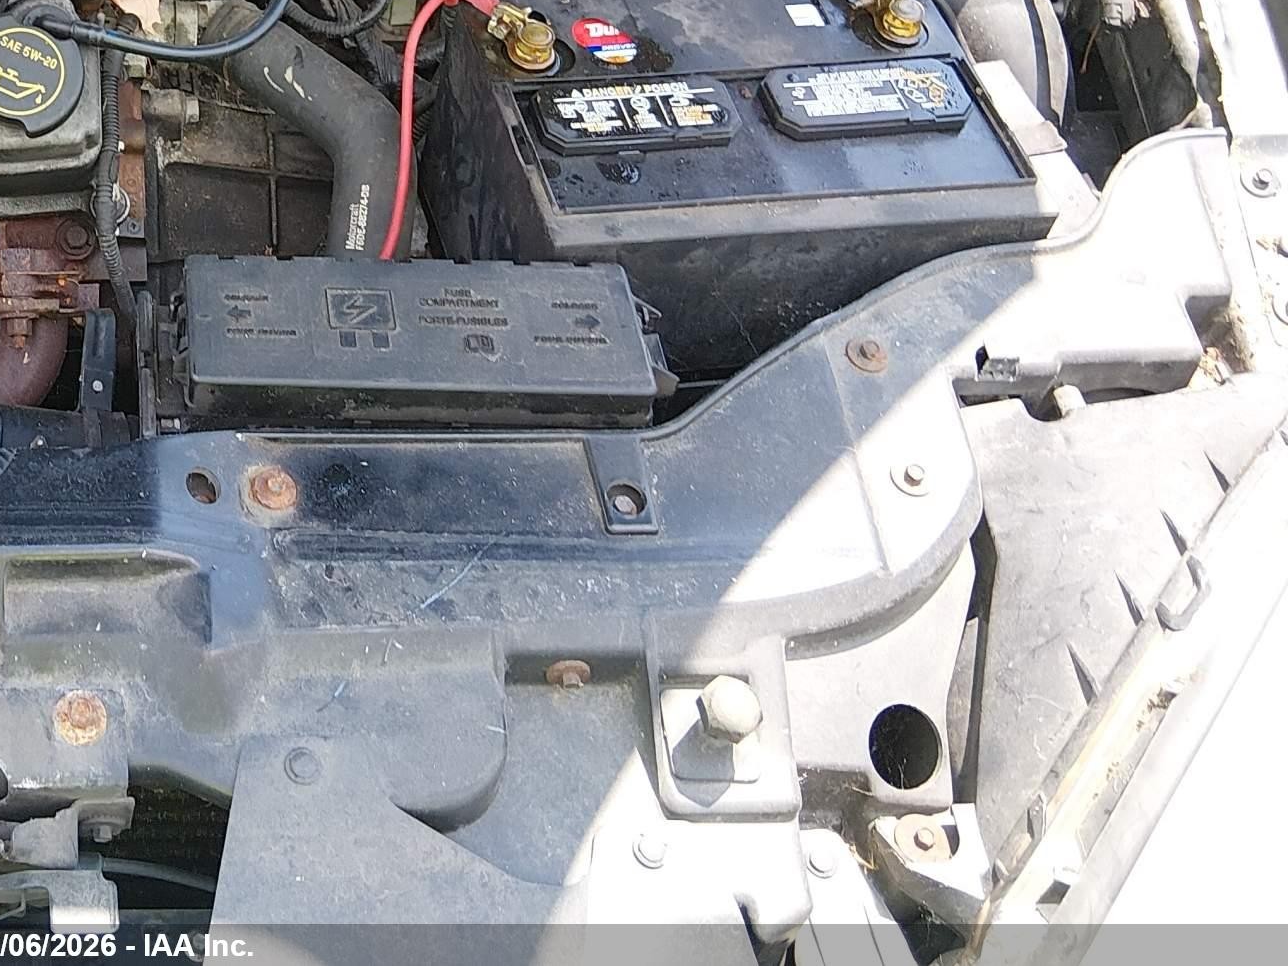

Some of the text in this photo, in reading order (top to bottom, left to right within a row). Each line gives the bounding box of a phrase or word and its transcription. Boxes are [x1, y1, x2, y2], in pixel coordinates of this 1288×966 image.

[0, 36, 58, 70] SAE 5W-20
[643, 81, 689, 93] POISON
[443, 287, 473, 298] FUSE
[418, 297, 500, 309] COMPARTMENT
[417, 315, 509, 327] PORTE-FUSIBLES
